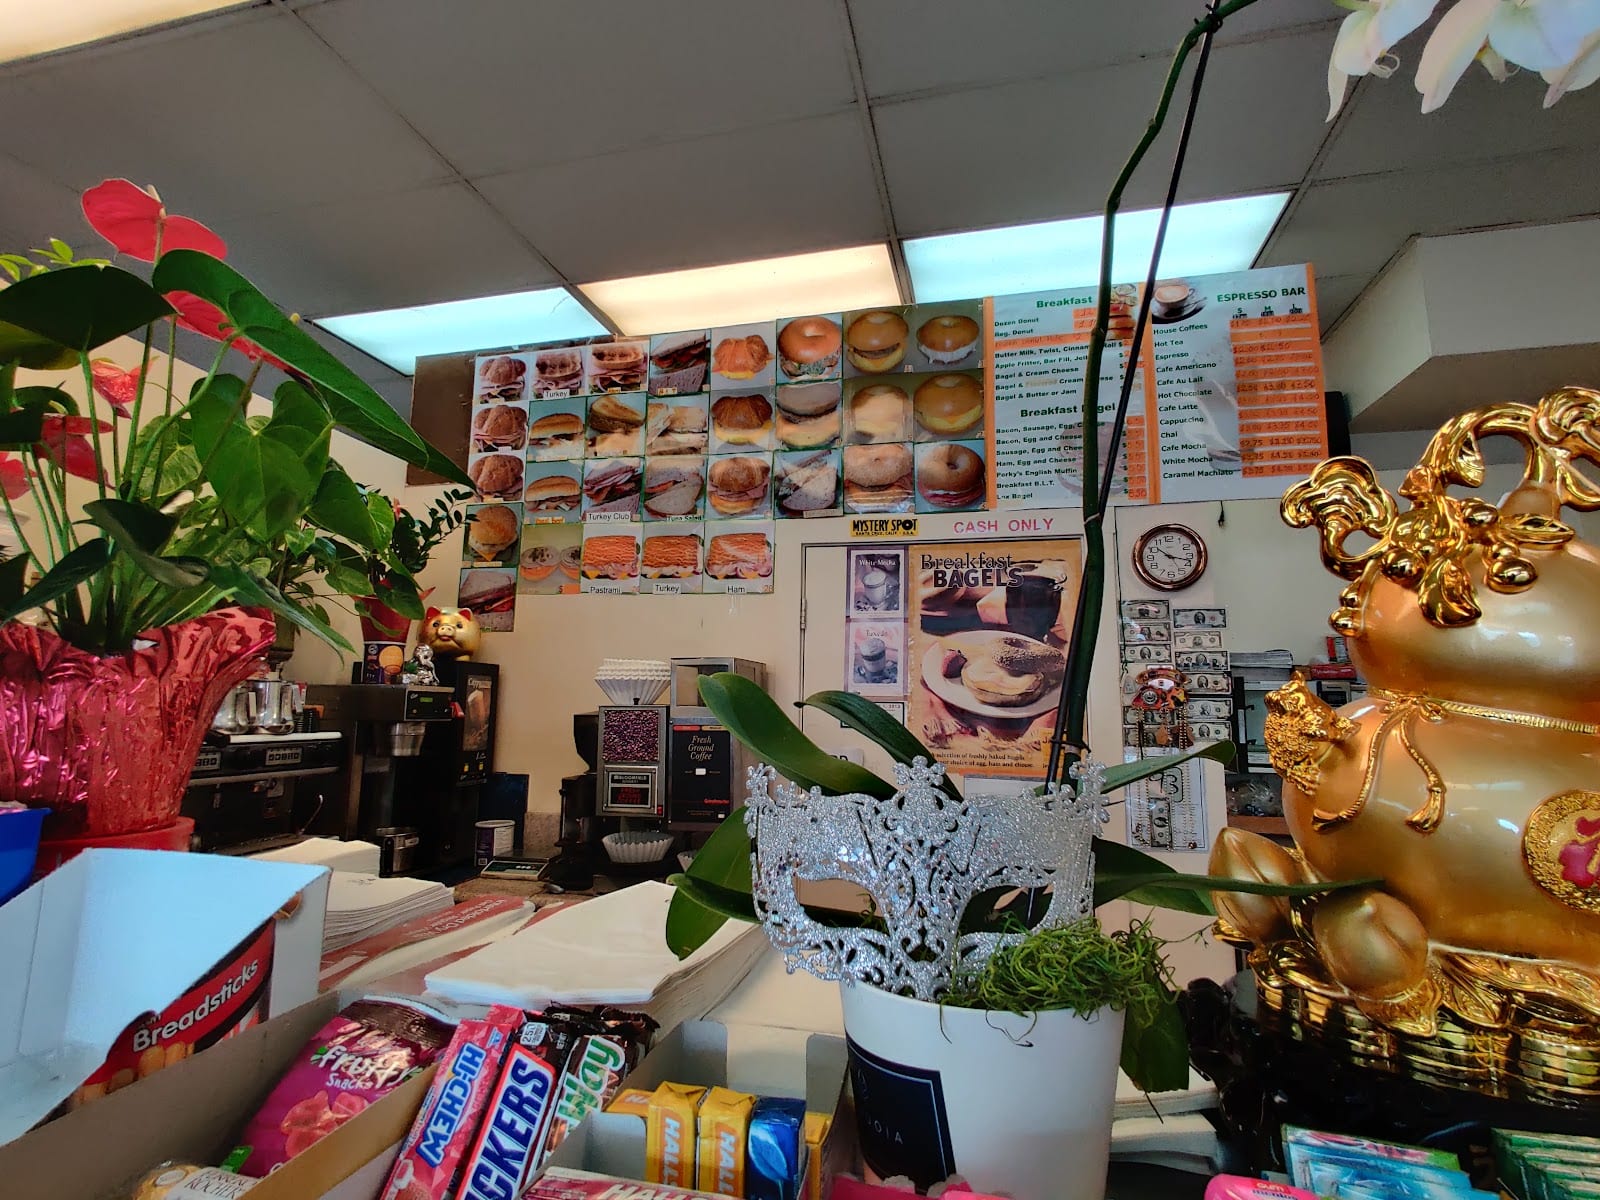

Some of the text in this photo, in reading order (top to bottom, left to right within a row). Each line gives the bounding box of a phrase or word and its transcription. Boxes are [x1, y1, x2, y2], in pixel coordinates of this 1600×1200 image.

[1217, 287, 1306, 303] ESPRESSO BAR
[1036, 296, 1092, 308] Breakfast
[1153, 324, 1208, 335] House Coffees
[1154, 340, 1168, 348] Hot
[1155, 352, 1190, 361] Espresso
[1175, 362, 1217, 372] Americano
[995, 372, 1016, 380] Bagel
[996, 383, 1016, 391] Bagel
[1156, 378, 1174, 386] Cafe
[545, 390, 568, 398] Turkey
[996, 394, 1016, 402] Bagel
[1060, 388, 1077, 396] Jam
[1174, 389, 1212, 398] Chocolate
[1020, 406, 1078, 418] Breakfast
[1160, 416, 1204, 426] Cappuccino
[996, 426, 1021, 434] Bacon,
[1023, 424, 1056, 432] Sausage,
[1023, 436, 1036, 444] Egg
[996, 448, 1029, 456] Sausage,
[1032, 446, 1046, 454] Egg
[1162, 442, 1206, 452] Cafe Mocha
[1162, 456, 1214, 466] White Mocha
[996, 470, 1023, 478] Porky's
[1025, 468, 1052, 476] English
[1163, 470, 1195, 479] Caramel
[996, 480, 1032, 489] Breakfast
[1012, 492, 1033, 500] Bagel
[588, 512, 630, 521] Turkey Club
[852, 518, 918, 532] MYSTERY SPOT
[954, 518, 1054, 534] CASH ONLY
[1154, 538, 1162, 546] 11
[921, 552, 1014, 570] Breakfast
[1146, 554, 1154, 562] 9
[1186, 552, 1194, 560] 3
[1150, 562, 1158, 570] 8
[1184, 560, 1192, 568] 4
[933, 566, 1025, 588] BAGELS
[1168, 570, 1176, 578] 6
[1178, 568, 1186, 576] 5
[590, 586, 620, 594] Pastrami
[655, 584, 680, 594] Turkey
[692, 736, 712, 744] Fresh
[688, 744, 715, 752] Ground
[690, 752, 712, 762] Coffee
[133, 959, 259, 1053] Breadsticks
[325, 1072, 374, 1090] Snacks
[417, 1043, 487, 1168] HI-CHEW
[663, 1116, 681, 1187] HALL
[718, 1130, 736, 1195] HALL
